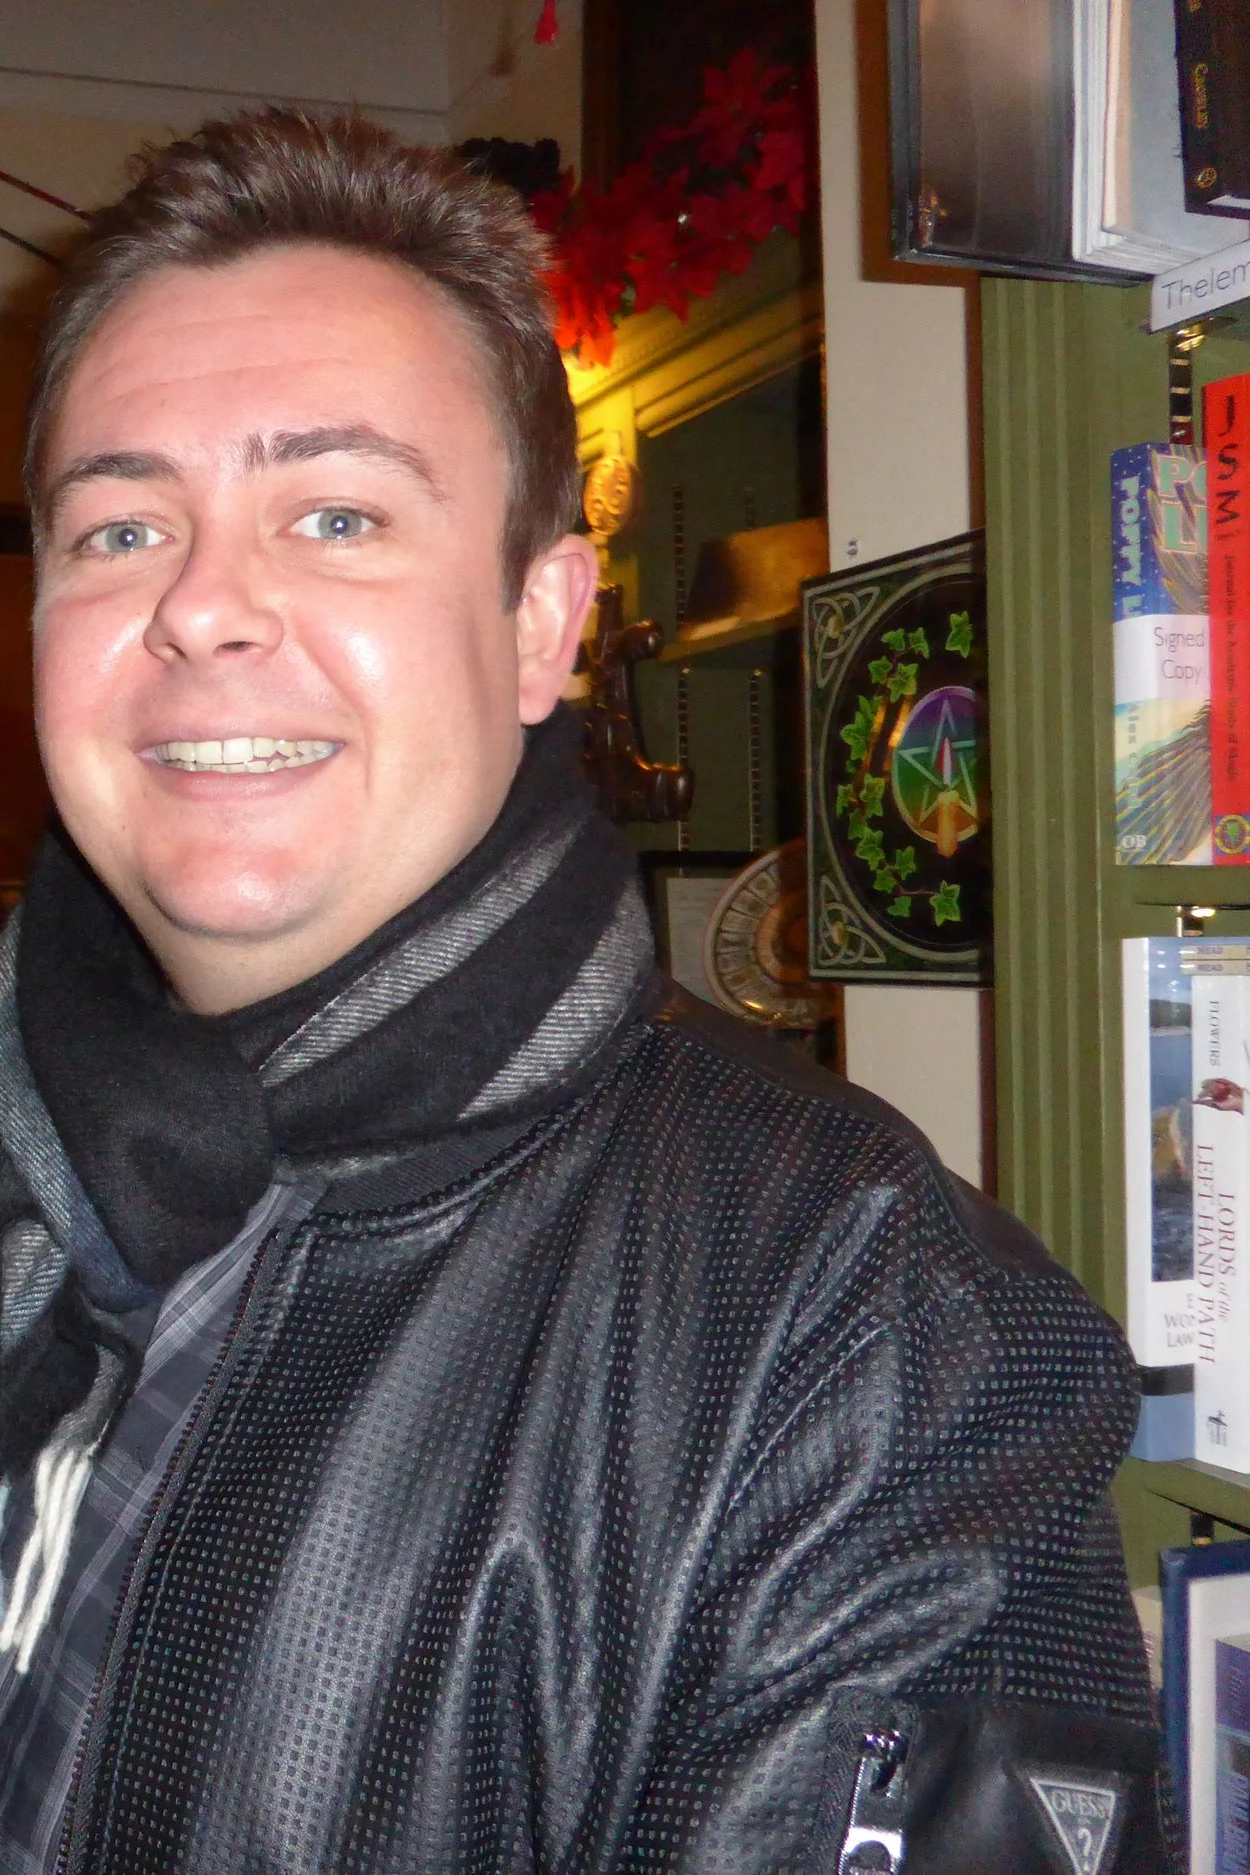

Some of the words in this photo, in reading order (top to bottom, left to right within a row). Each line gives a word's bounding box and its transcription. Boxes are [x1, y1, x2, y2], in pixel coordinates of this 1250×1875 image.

[1120, 476, 1141, 585] POPPY
[1154, 626, 1205, 653] Signed
[1162, 659, 1202, 684] Copy
[1217, 1192, 1238, 1276] LORDS
[1197, 1295, 1216, 1364] PATH
